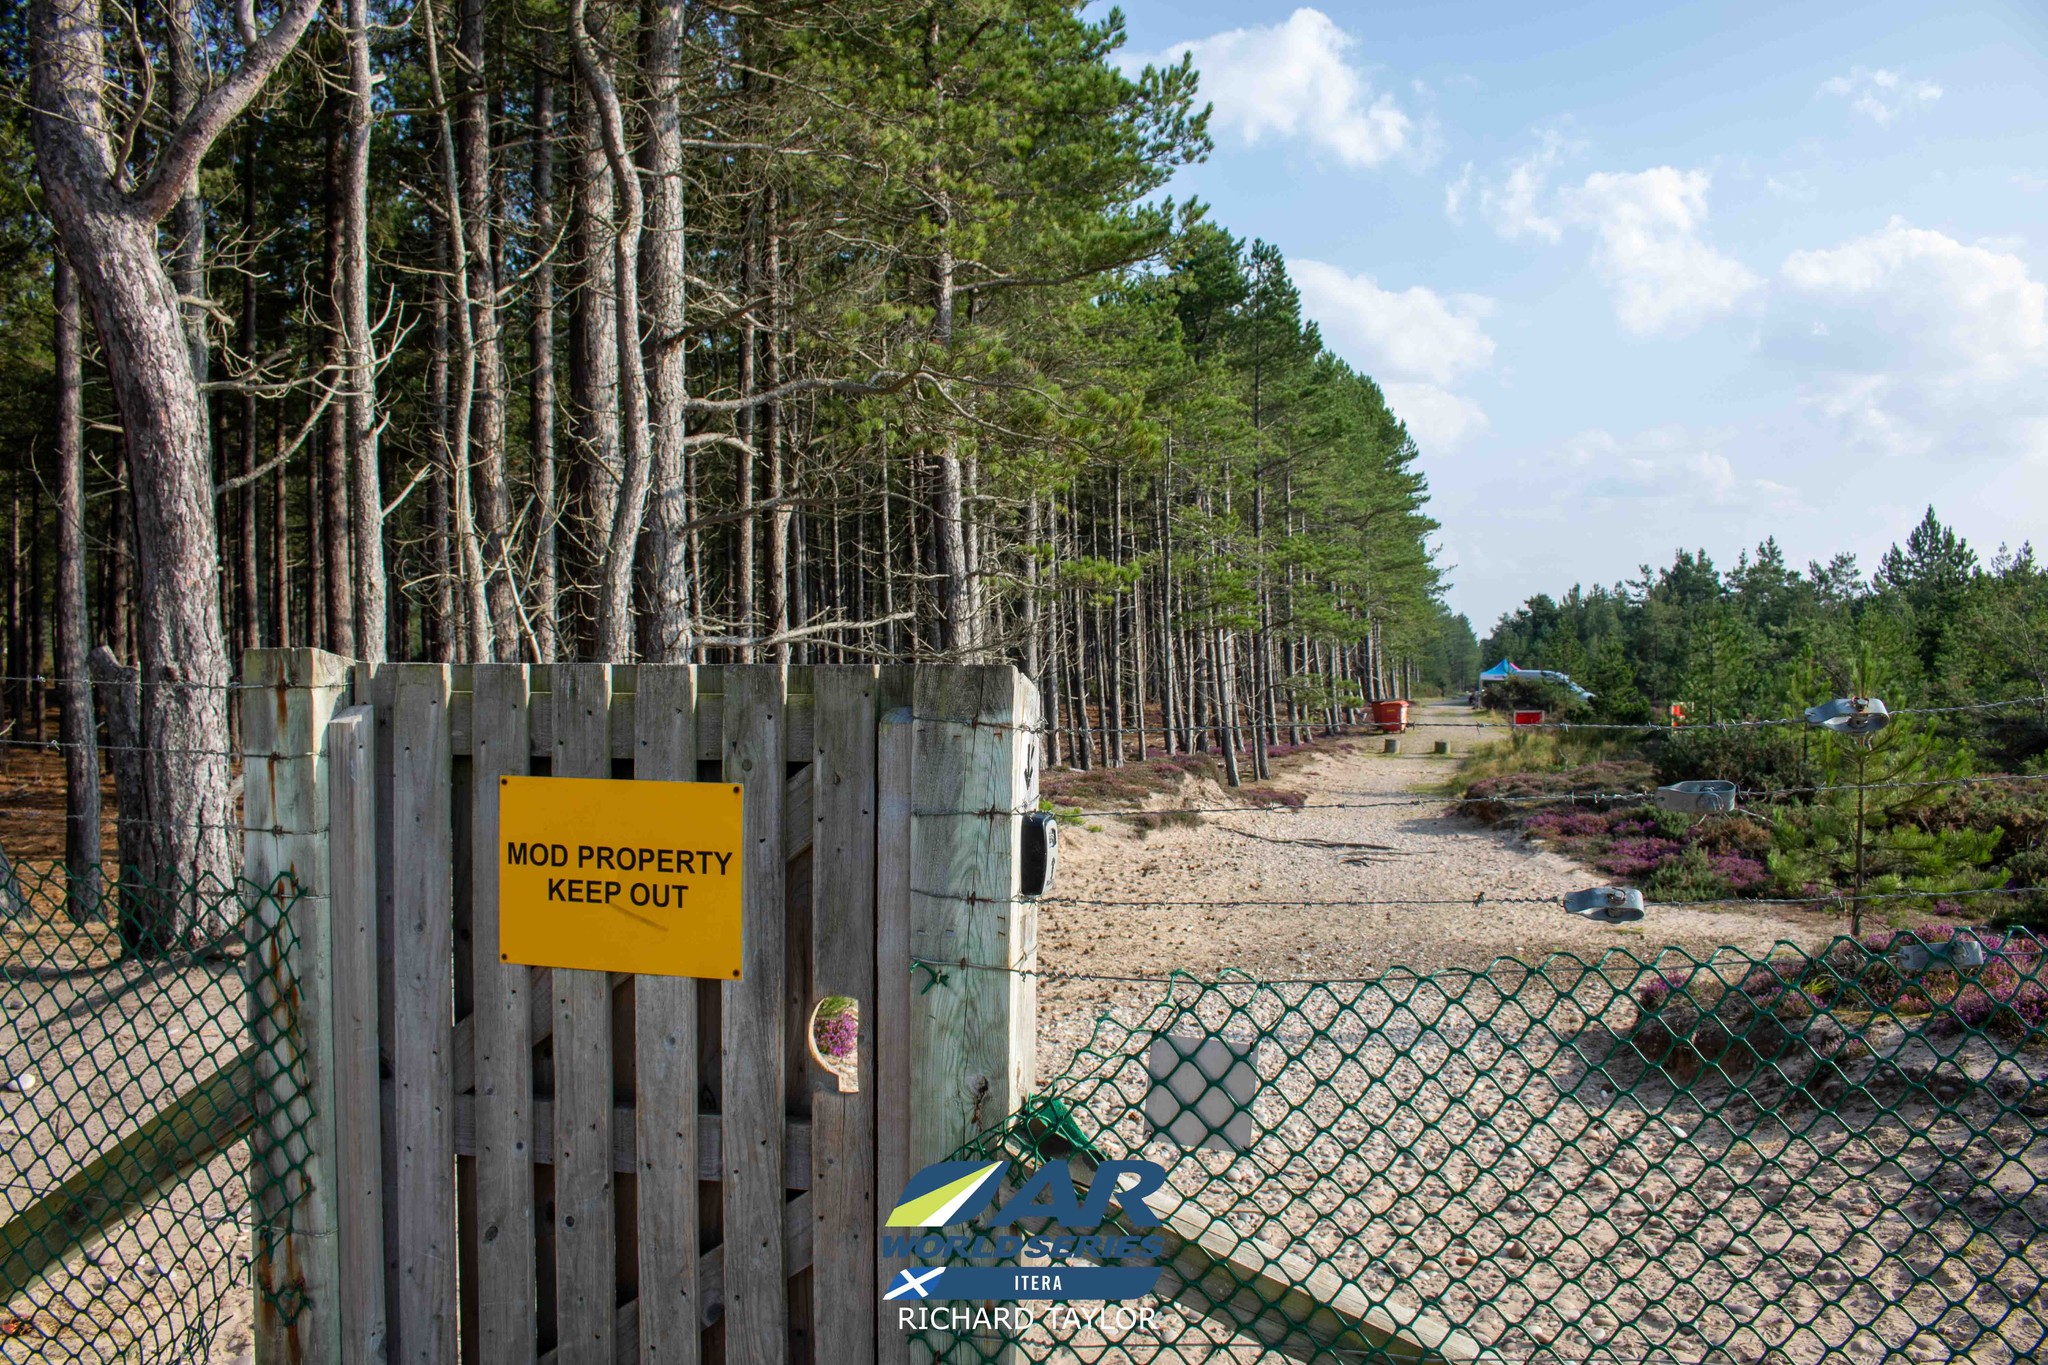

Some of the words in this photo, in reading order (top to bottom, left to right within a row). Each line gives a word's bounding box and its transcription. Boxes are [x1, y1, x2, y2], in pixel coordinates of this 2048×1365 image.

[507, 842, 568, 867] MOD
[578, 845, 733, 875] PROPERTY
[548, 878, 621, 904] KEEP
[630, 882, 689, 908] OUT
